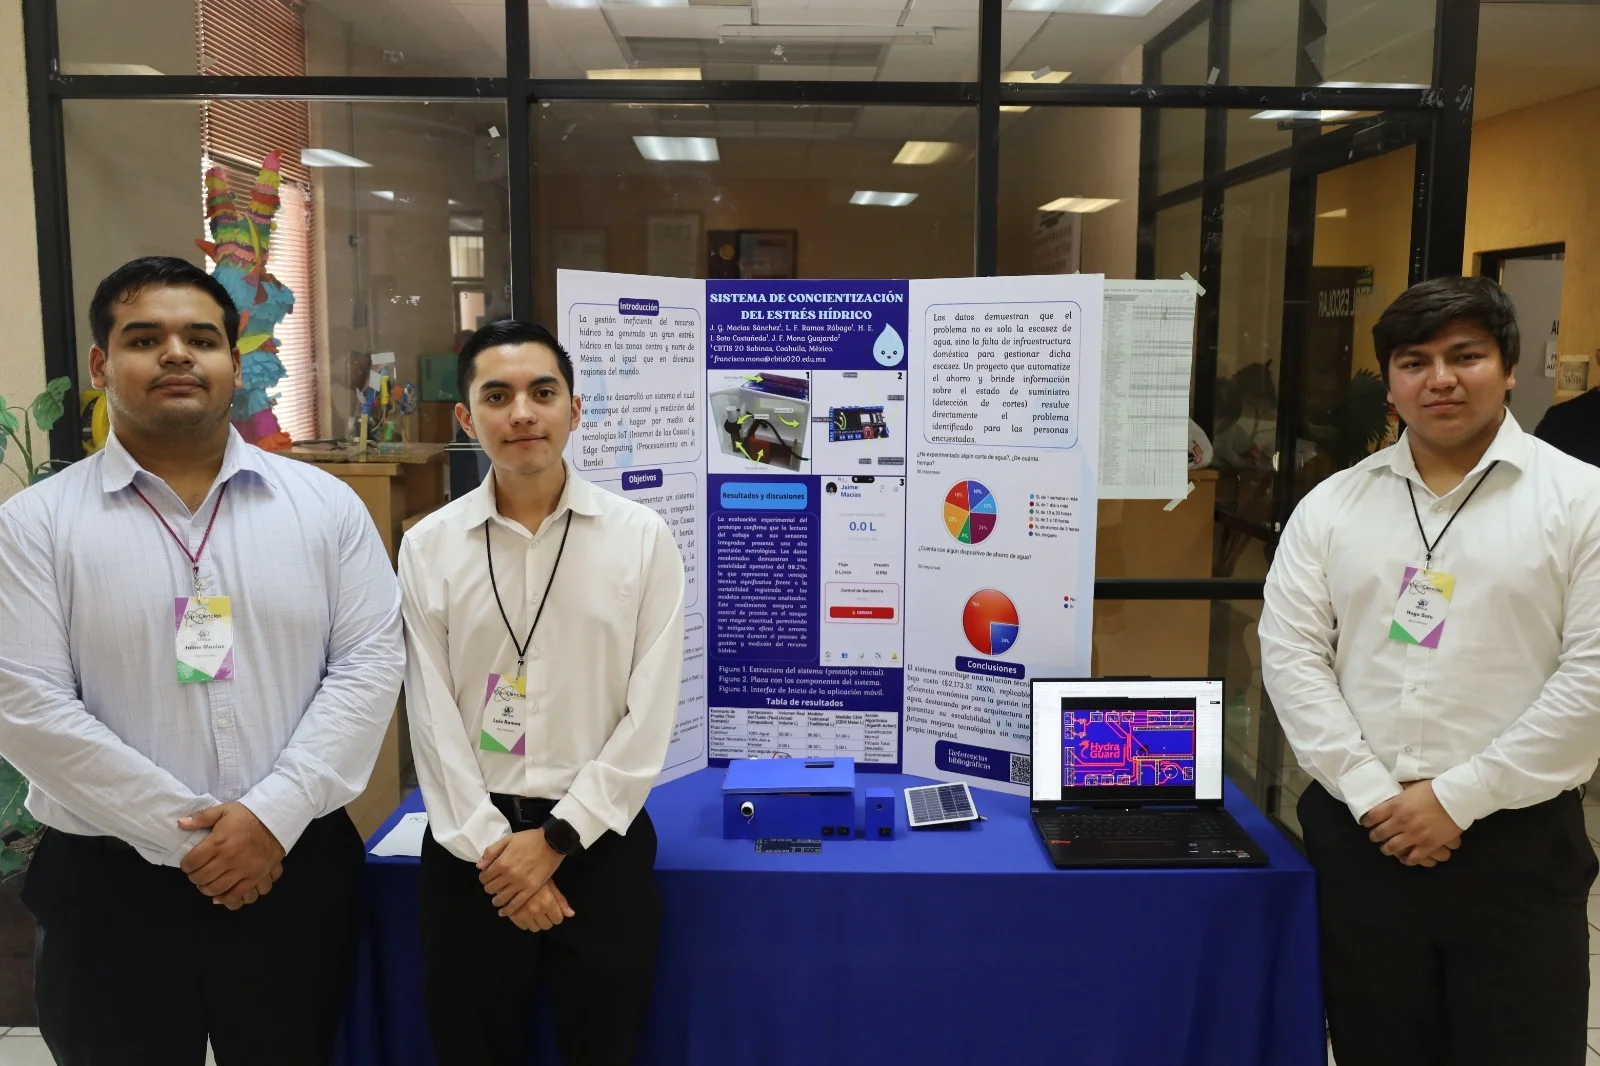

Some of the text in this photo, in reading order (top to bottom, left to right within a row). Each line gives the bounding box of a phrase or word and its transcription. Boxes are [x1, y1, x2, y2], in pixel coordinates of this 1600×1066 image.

[710, 291, 903, 303] SISTEMA DE CONCIENTIZACIÓN
[619, 302, 658, 312] Introducción
[741, 307, 872, 320] DEL ESTRÉS HÍDRICO
[934, 313, 945, 321] Los
[955, 313, 974, 321] datos
[1040, 313, 1053, 322] que
[1065, 311, 1072, 319] el
[579, 315, 586, 323] La
[595, 316, 616, 325] gestión
[624, 317, 652, 326] ineficiente
[675, 319, 694, 327] recurso
[580, 328, 601, 336] hídrico
[619, 330, 645, 339] generado
[662, 332, 674, 340] gran
[679, 330, 694, 339] estrés
[933, 326, 966, 335] problema
[997, 325, 1012, 333] solo
[1062, 324, 1071, 332] de
[580, 341, 601, 349] hídrico
[615, 342, 623, 350] las
[981, 337, 998, 347] falta
[1001, 337, 1010, 345] de
[1013, 337, 1071, 347] infraestructura
[933, 349, 1071, 359] doméstica para gestionar dicha
[963, 362, 973, 370] Un
[976, 363, 1008, 372] proyecto
[1011, 364, 1024, 372] que
[1028, 363, 1070, 371] automatize
[978, 376, 982, 384] y
[991, 375, 1015, 383] brinde
[1023, 376, 1070, 385] información
[933, 386, 951, 394] sobre
[976, 387, 1000, 395] estado
[1029, 388, 1069, 396] suministro
[932, 399, 968, 407] (detección
[981, 399, 989, 407] de
[1003, 400, 1028, 408] cortes)
[932, 411, 1069, 422] directamente el problema
[932, 423, 1068, 435] identificado para las personas
[932, 435, 976, 444] encuestadas.
[629, 474, 656, 484] Objetivos
[850, 522, 876, 532] 0.0 L
[719, 666, 740, 674] Figura
[749, 666, 783, 674] Estructura
[798, 667, 823, 675] sistema
[825, 668, 858, 676] (prototipo
[860, 668, 885, 676] inicial).
[968, 660, 1017, 674] Conclusiones
[915, 666, 936, 674] sistema
[986, 675, 1012, 685] solución
[719, 676, 740, 684] Figura
[796, 678, 839, 686] componentes
[719, 686, 740, 694] Figura
[750, 686, 776, 695] Interfaz
[827, 688, 862, 697] aplicación
[766, 698, 843, 707] Tabla de resultados
[1090, 742, 1120, 752] Hydra
[948, 749, 988, 762] Referencias
[1090, 750, 1120, 759] Guard
[948, 756, 991, 770] bibliográficas
